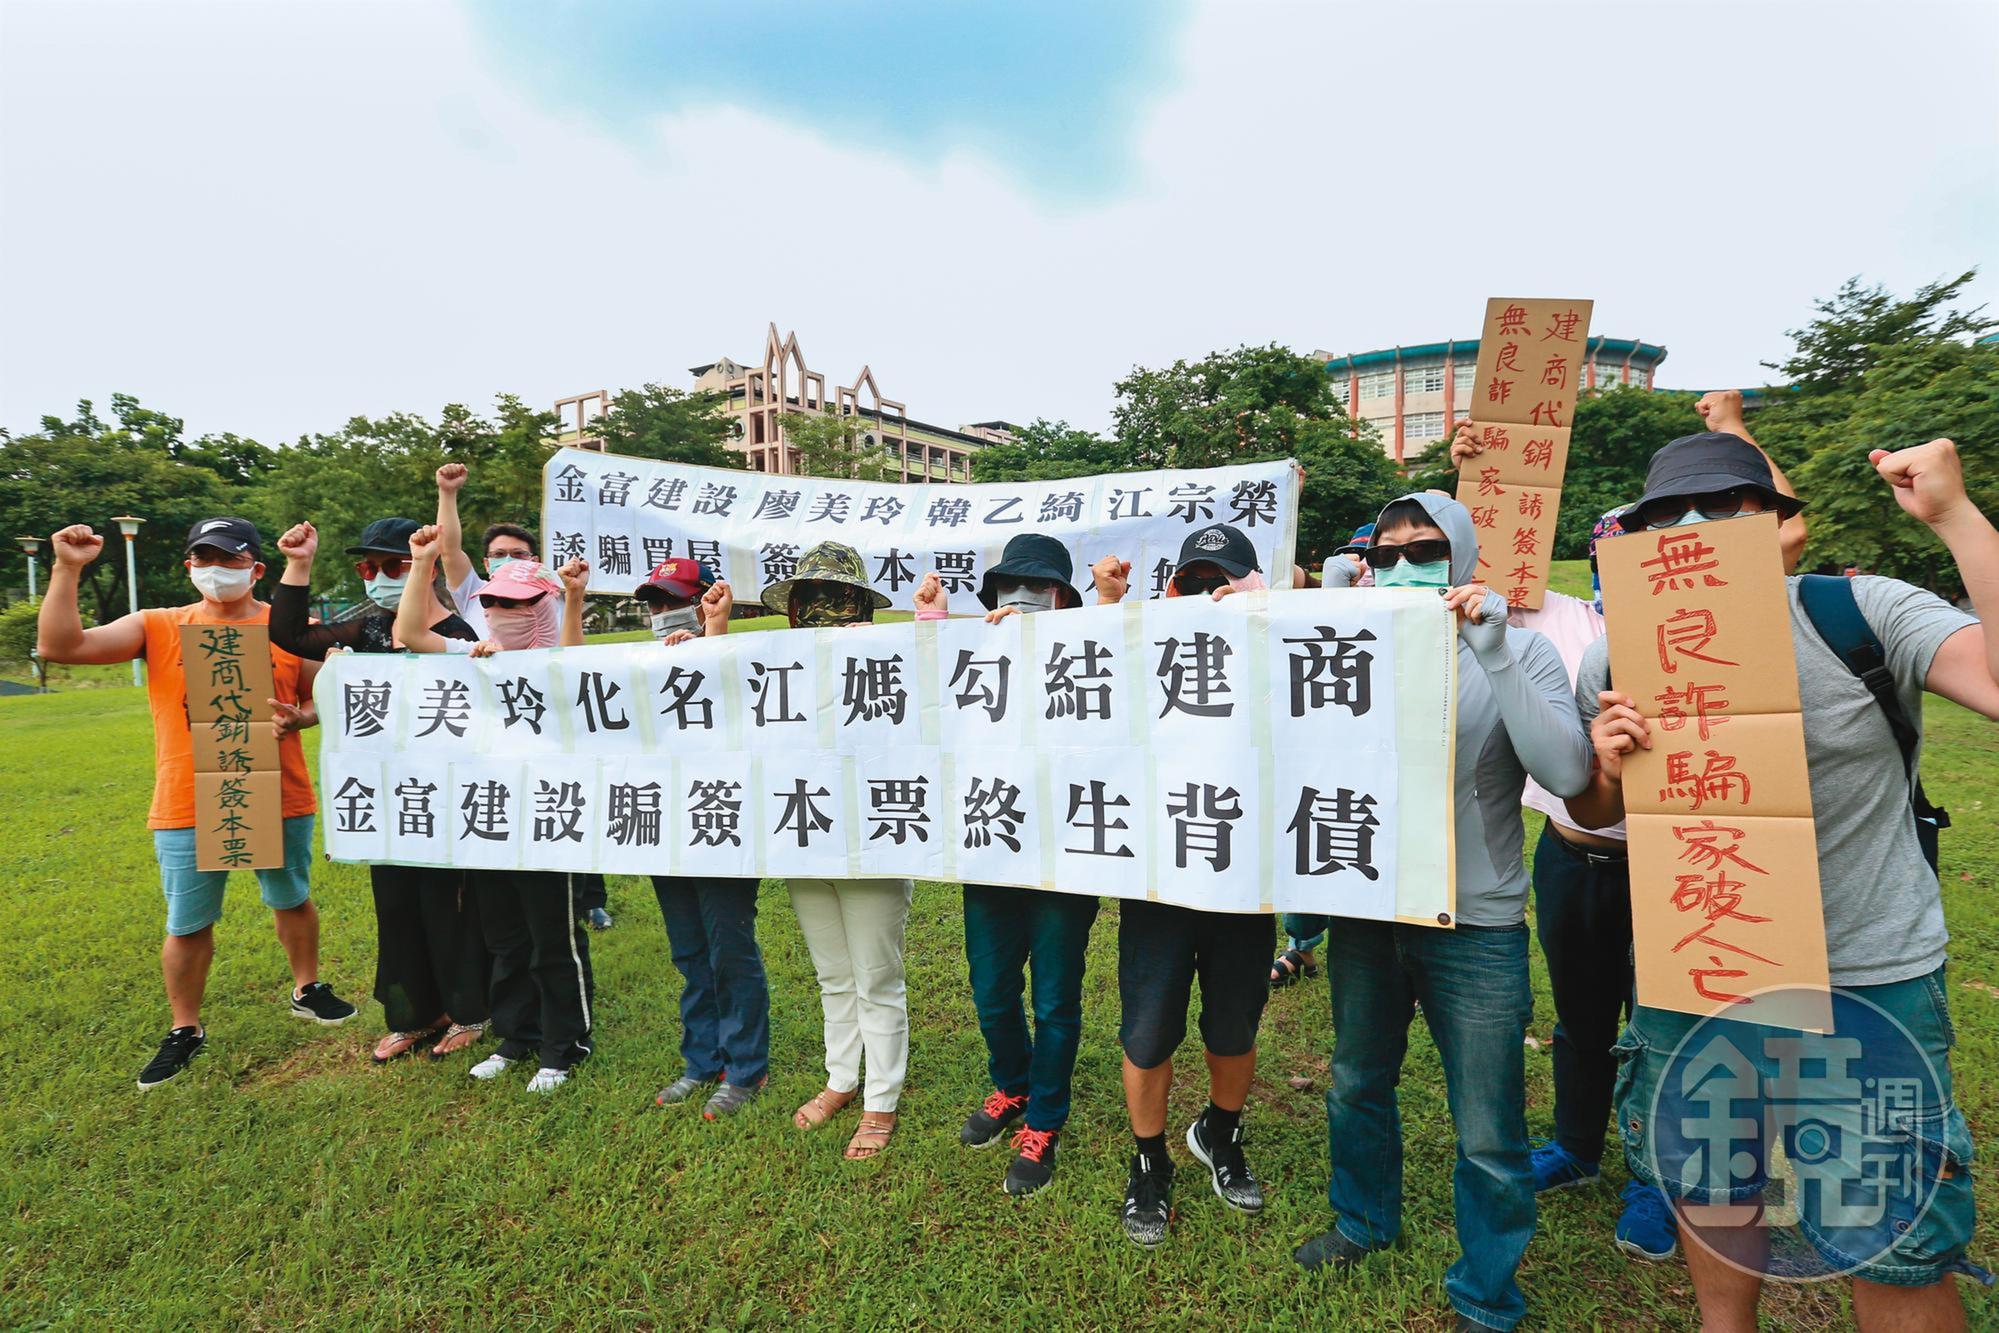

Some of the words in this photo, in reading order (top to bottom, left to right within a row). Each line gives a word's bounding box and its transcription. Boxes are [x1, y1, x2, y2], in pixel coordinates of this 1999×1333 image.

[1471, 304, 1531, 583] 無良詐騙家破
[199, 626, 255, 867] 建商代銷誘簽本票
[344, 626, 1377, 738] 廖美玲化名江媽勾結建商
[1640, 532, 1784, 1003] 無良詐騙家破人亡
[333, 775, 1381, 881] 金富建設騙簽本票終生背債
